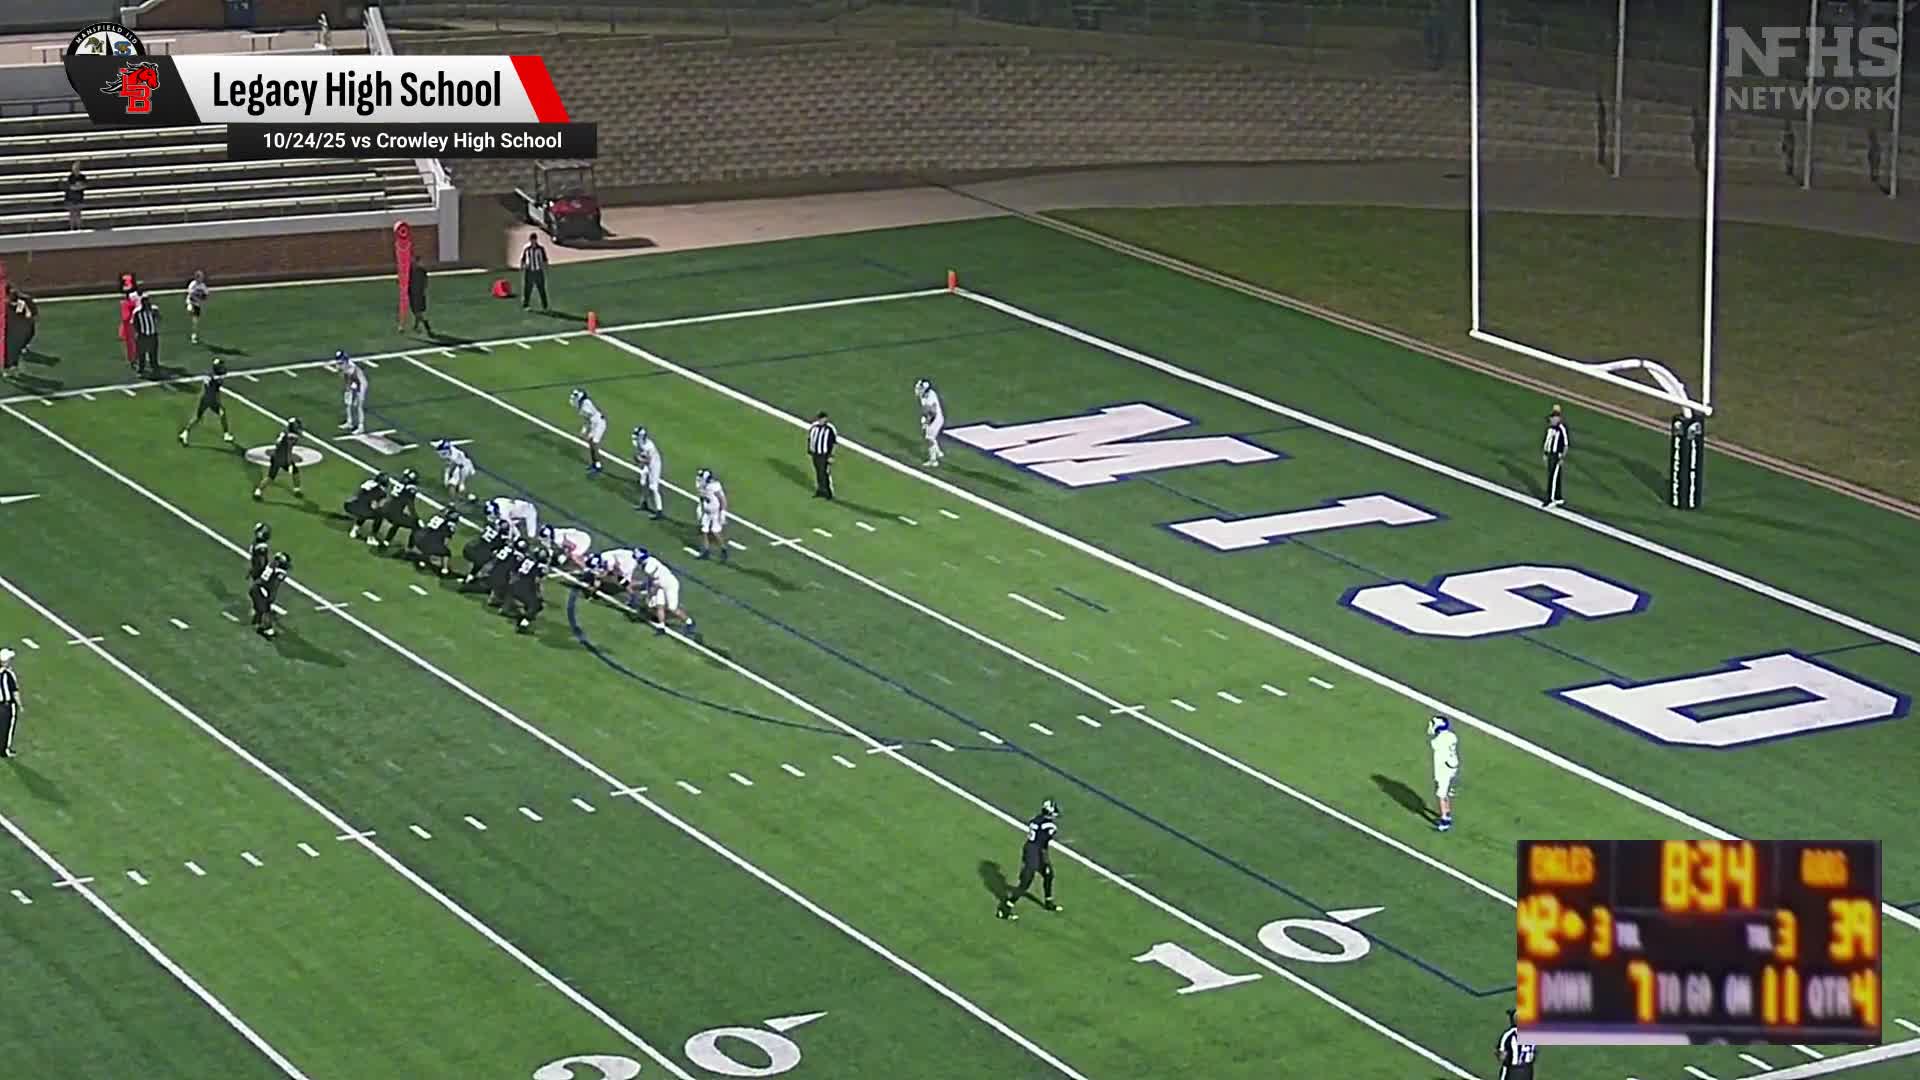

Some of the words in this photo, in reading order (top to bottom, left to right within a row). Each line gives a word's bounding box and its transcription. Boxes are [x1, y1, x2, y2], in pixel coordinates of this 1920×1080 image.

[942, 402, 1911, 747] MISD
[1661, 840, 1756, 911] 8:34
[1132, 918, 1371, 995] 10
[1590, 904, 1612, 958] 3
[1775, 908, 1797, 960] 3
[1828, 898, 1876, 961] 39
[1541, 971, 1593, 1012] DOWN
[1627, 961, 1655, 1023] 7
[1658, 972, 1682, 1014] TO
[1685, 972, 1713, 1014] GO
[1761, 964, 1800, 1025] 11
[1807, 976, 1850, 1018] QTR
[1851, 970, 1878, 1026] 4
